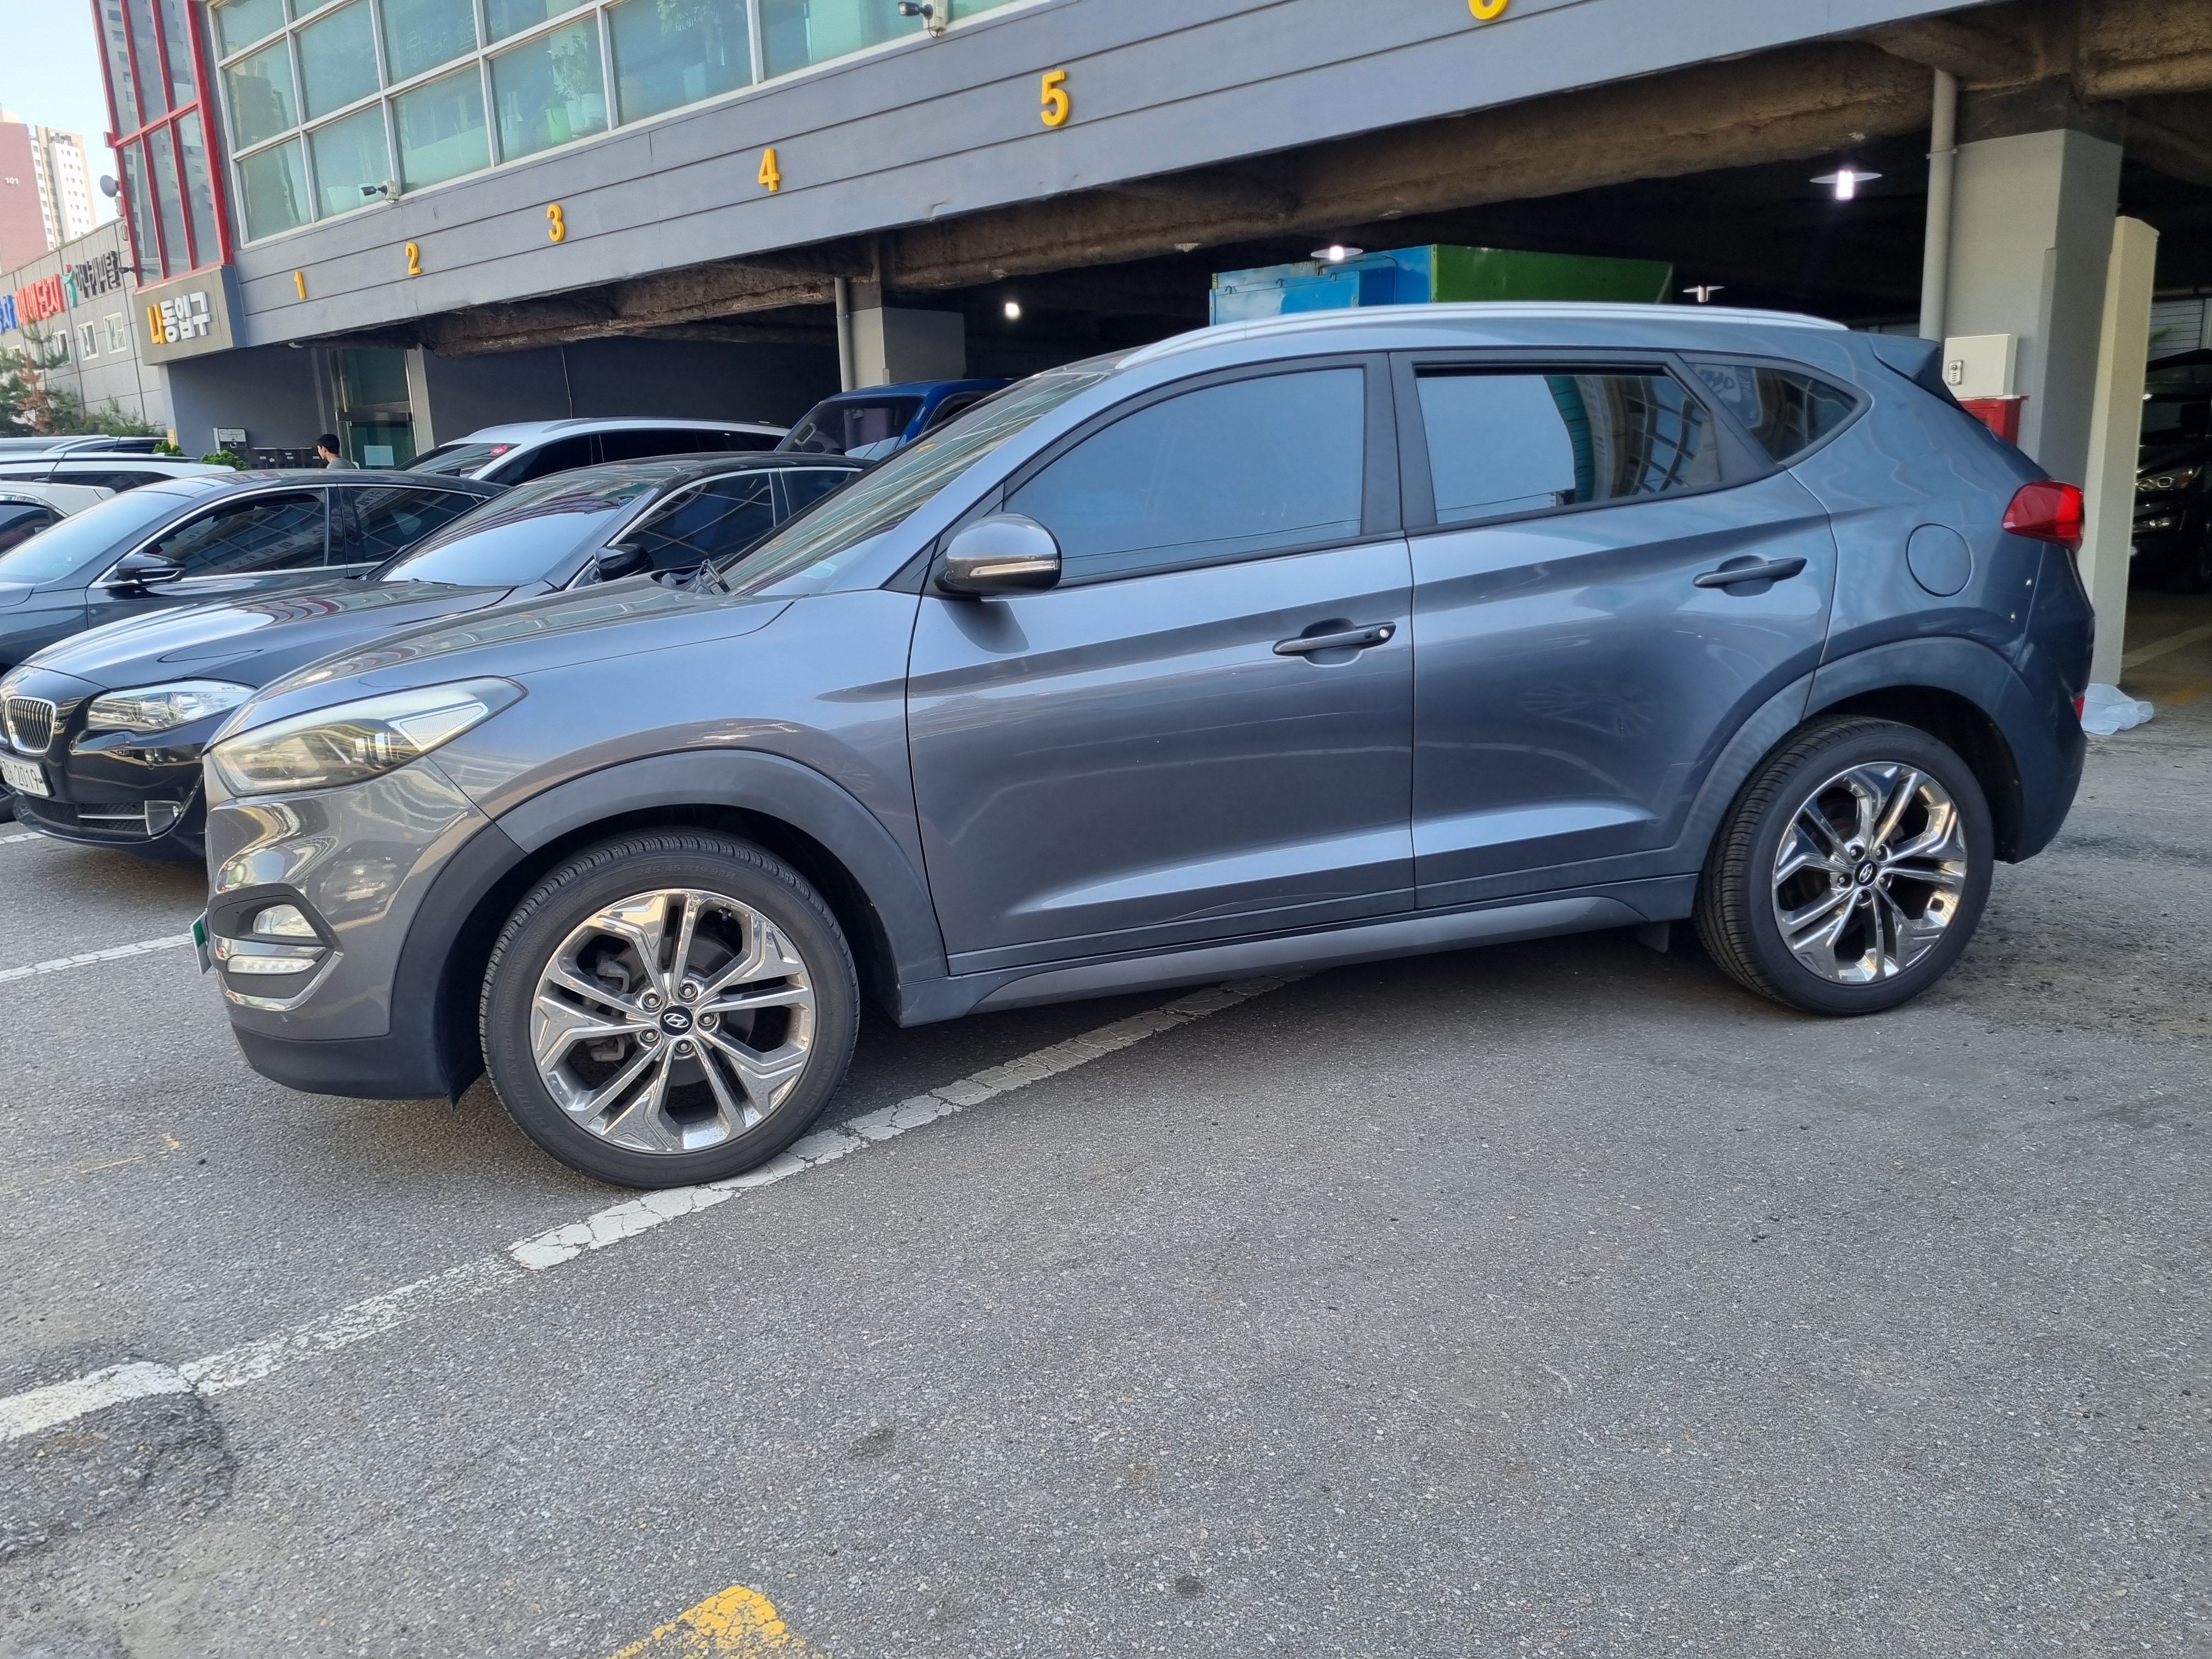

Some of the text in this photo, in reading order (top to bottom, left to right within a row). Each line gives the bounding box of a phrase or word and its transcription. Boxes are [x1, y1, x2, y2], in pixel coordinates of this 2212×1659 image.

[1041, 70, 1069, 127] 5
[758, 148, 780, 191] 4
[546, 204, 565, 242] 3
[75, 250, 121, 298] 하나캐피탈
[405, 241, 422, 275] 2
[15, 273, 65, 324] 매매단지
[293, 270, 306, 299] 1
[14, 764, 40, 791] 2019
[636, 864, 736, 880] 245/45 R19 98H
